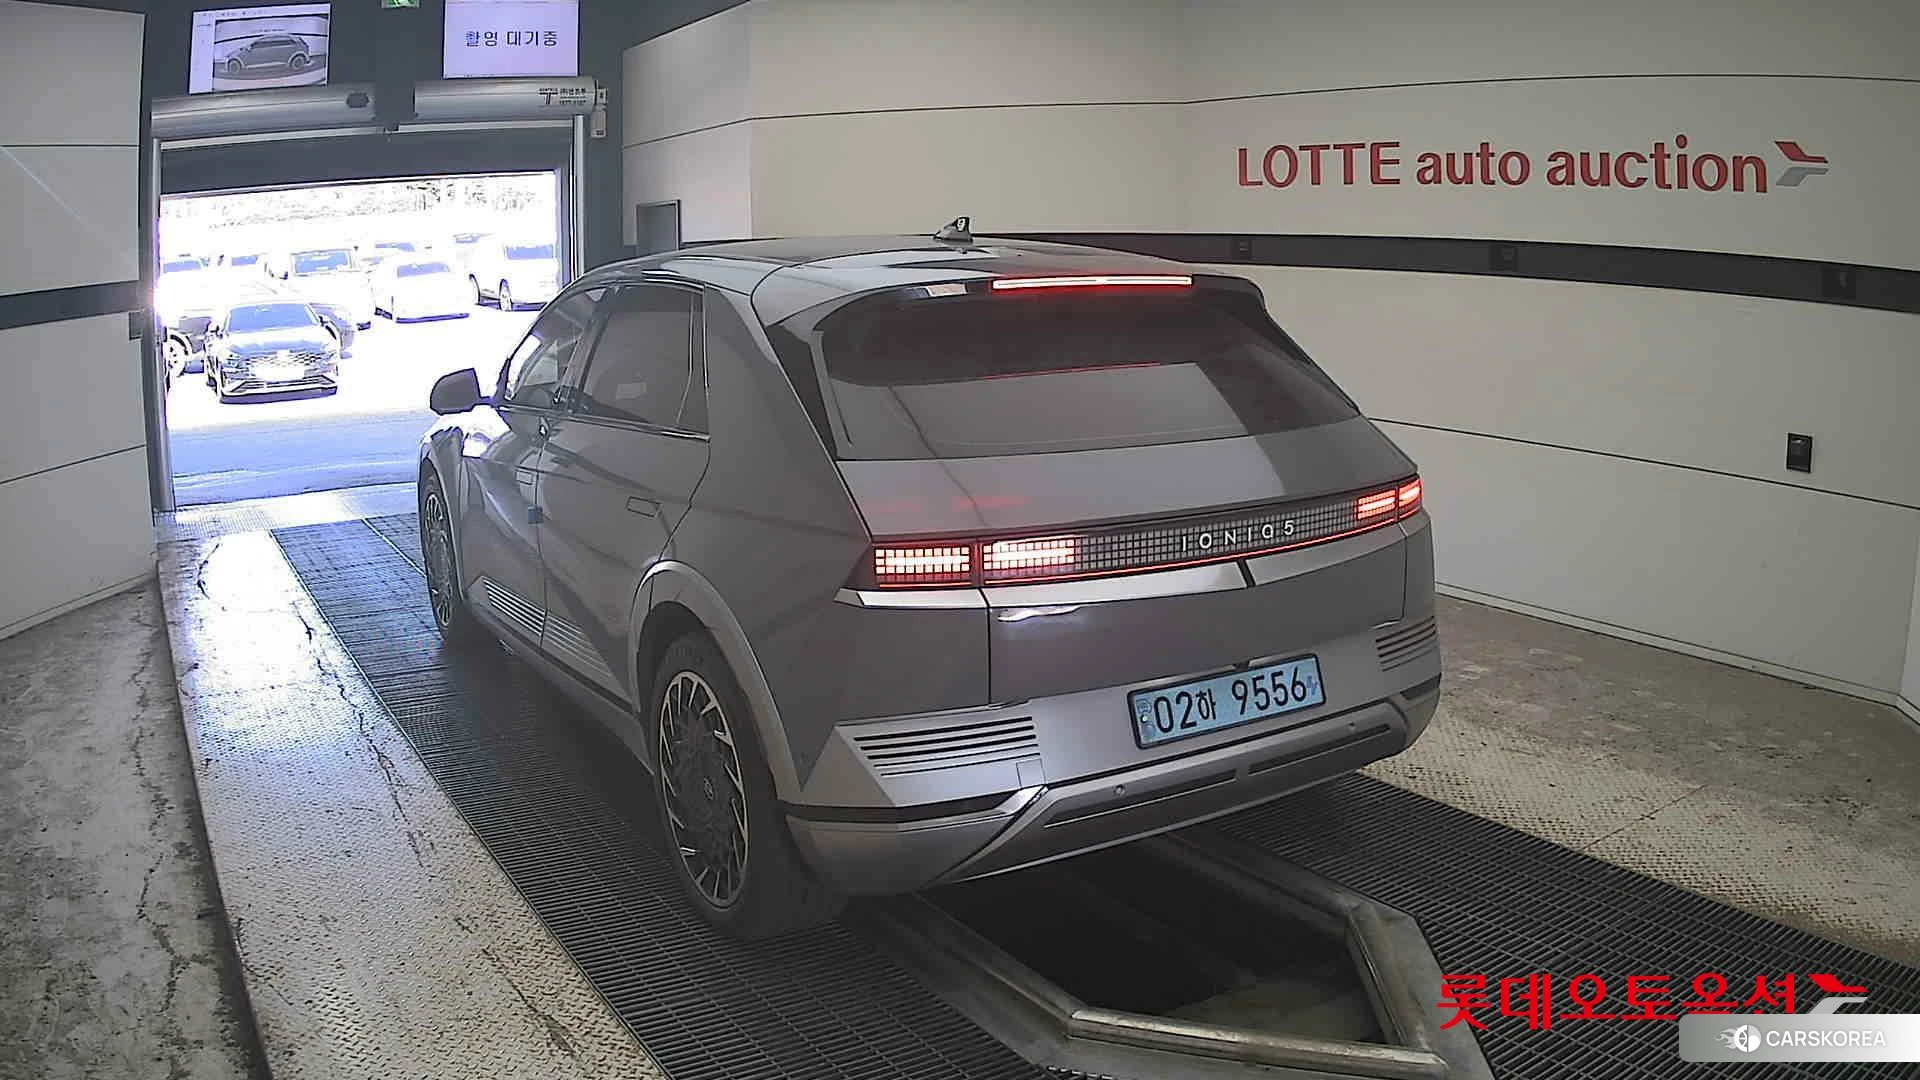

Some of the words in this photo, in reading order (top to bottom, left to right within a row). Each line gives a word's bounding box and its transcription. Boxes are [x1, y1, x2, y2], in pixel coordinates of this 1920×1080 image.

[507, 30, 557, 47] 대기중
[1238, 141, 1401, 187] LOTTE
[1416, 142, 1531, 186] auto
[1546, 134, 1768, 194] auction
[1153, 688, 1216, 734] 02하
[1231, 666, 1307, 716] 9556
